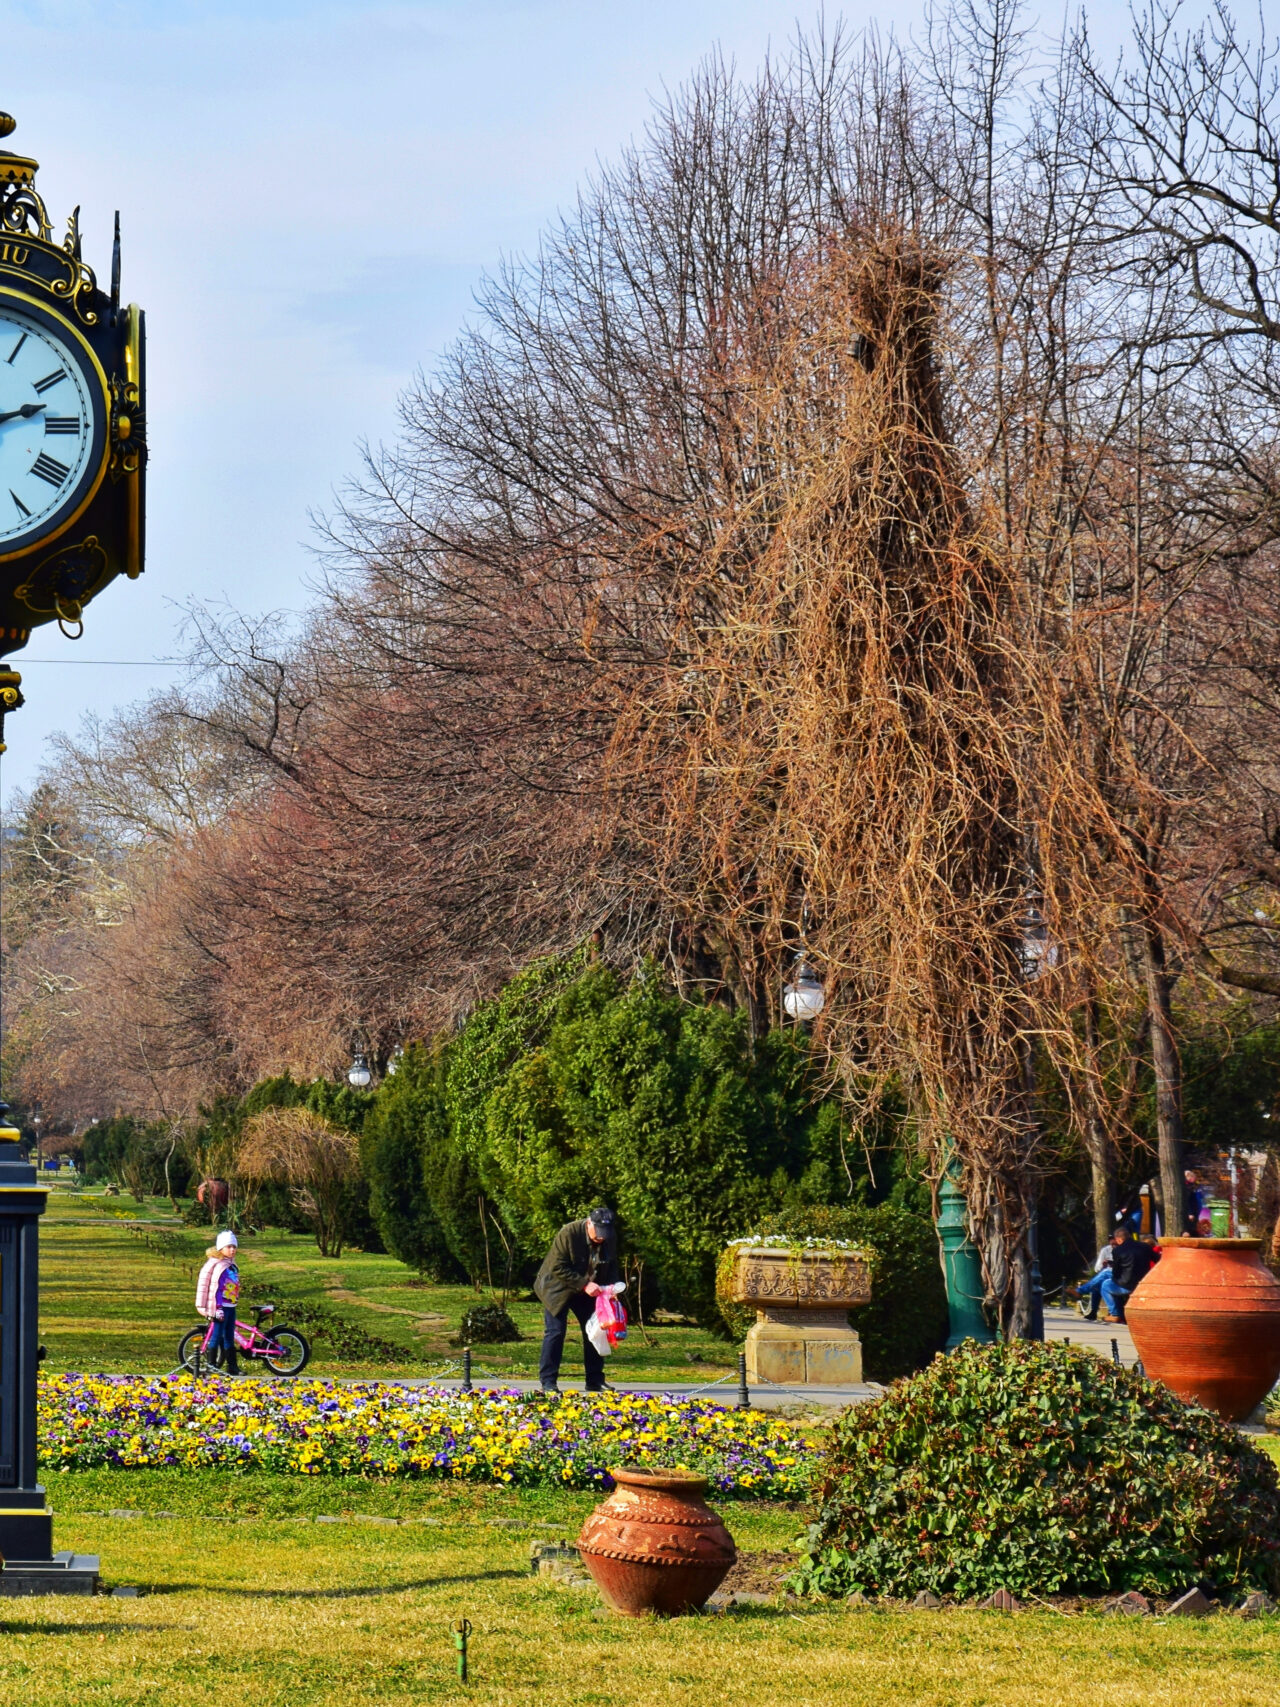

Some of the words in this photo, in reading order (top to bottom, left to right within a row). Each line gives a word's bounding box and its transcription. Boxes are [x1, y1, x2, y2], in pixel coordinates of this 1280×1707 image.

[3, 329, 32, 367] I
[31, 365, 70, 398] II
[44, 412, 80, 438] III
[9, 488, 36, 523] V
